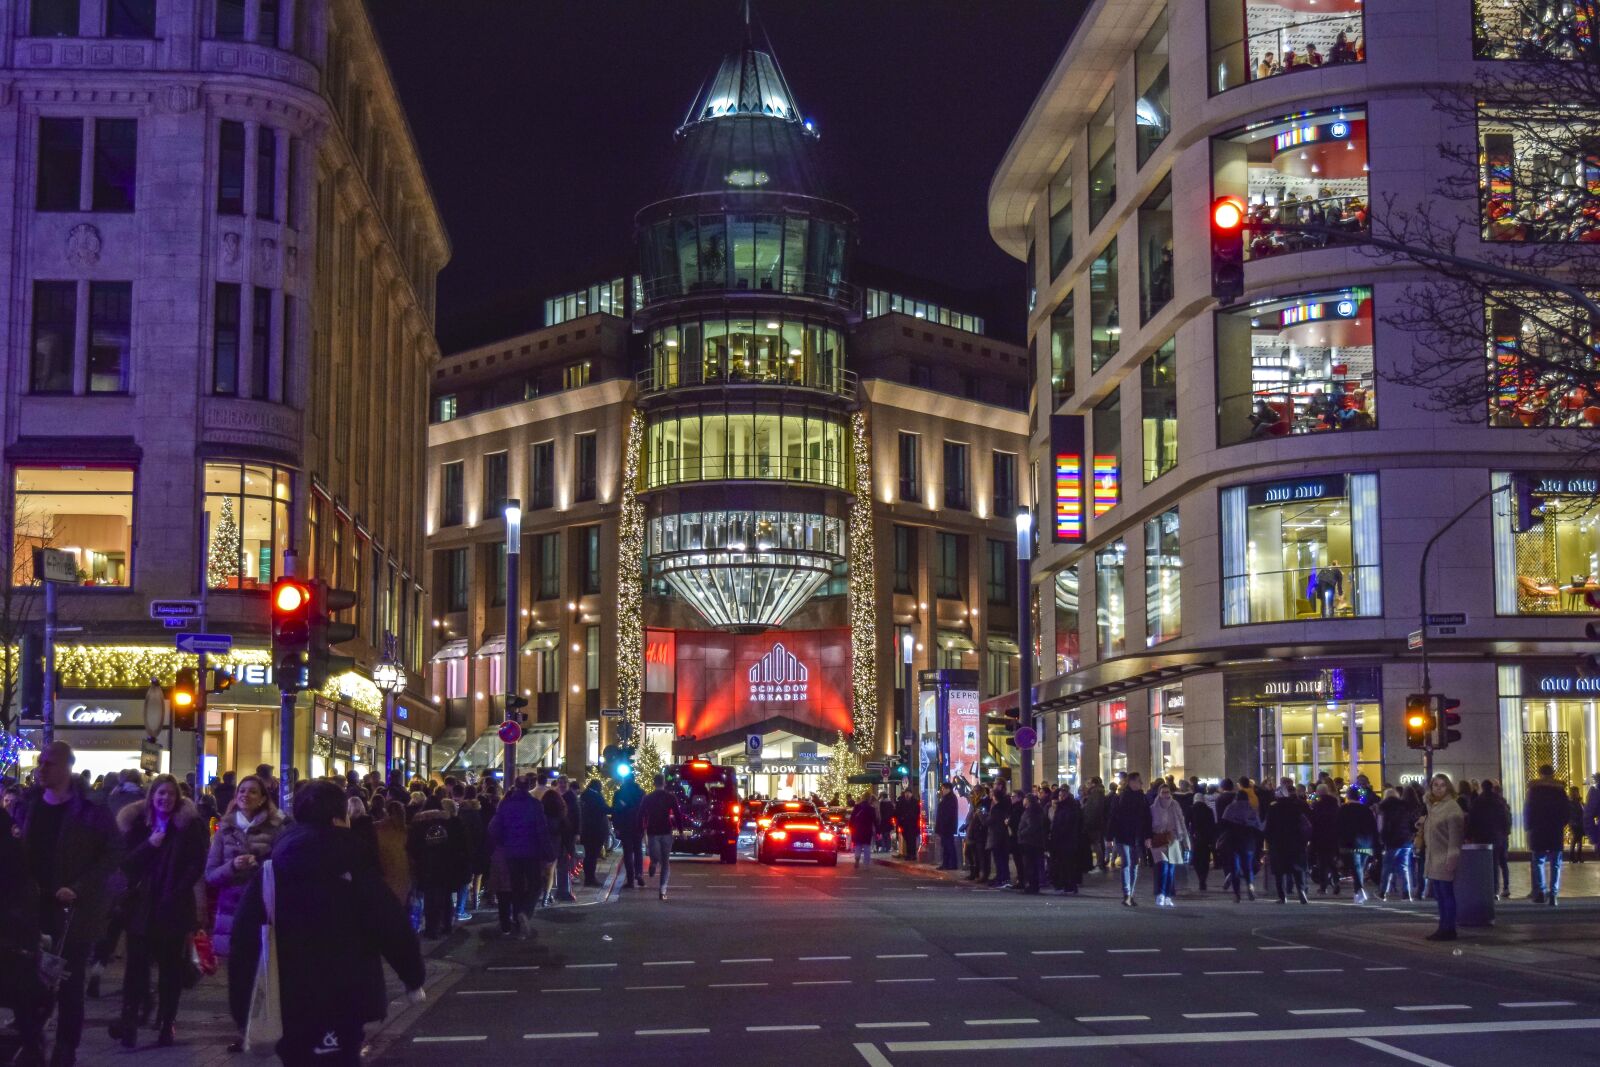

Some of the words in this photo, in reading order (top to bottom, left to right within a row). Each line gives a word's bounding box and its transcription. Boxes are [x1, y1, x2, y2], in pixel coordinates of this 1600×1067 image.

[750, 684, 808, 693] SCHADOW
[750, 693, 807, 701] ARKADEN
[69, 705, 121, 722] Cartier
[736, 765, 797, 773] SCADOW
